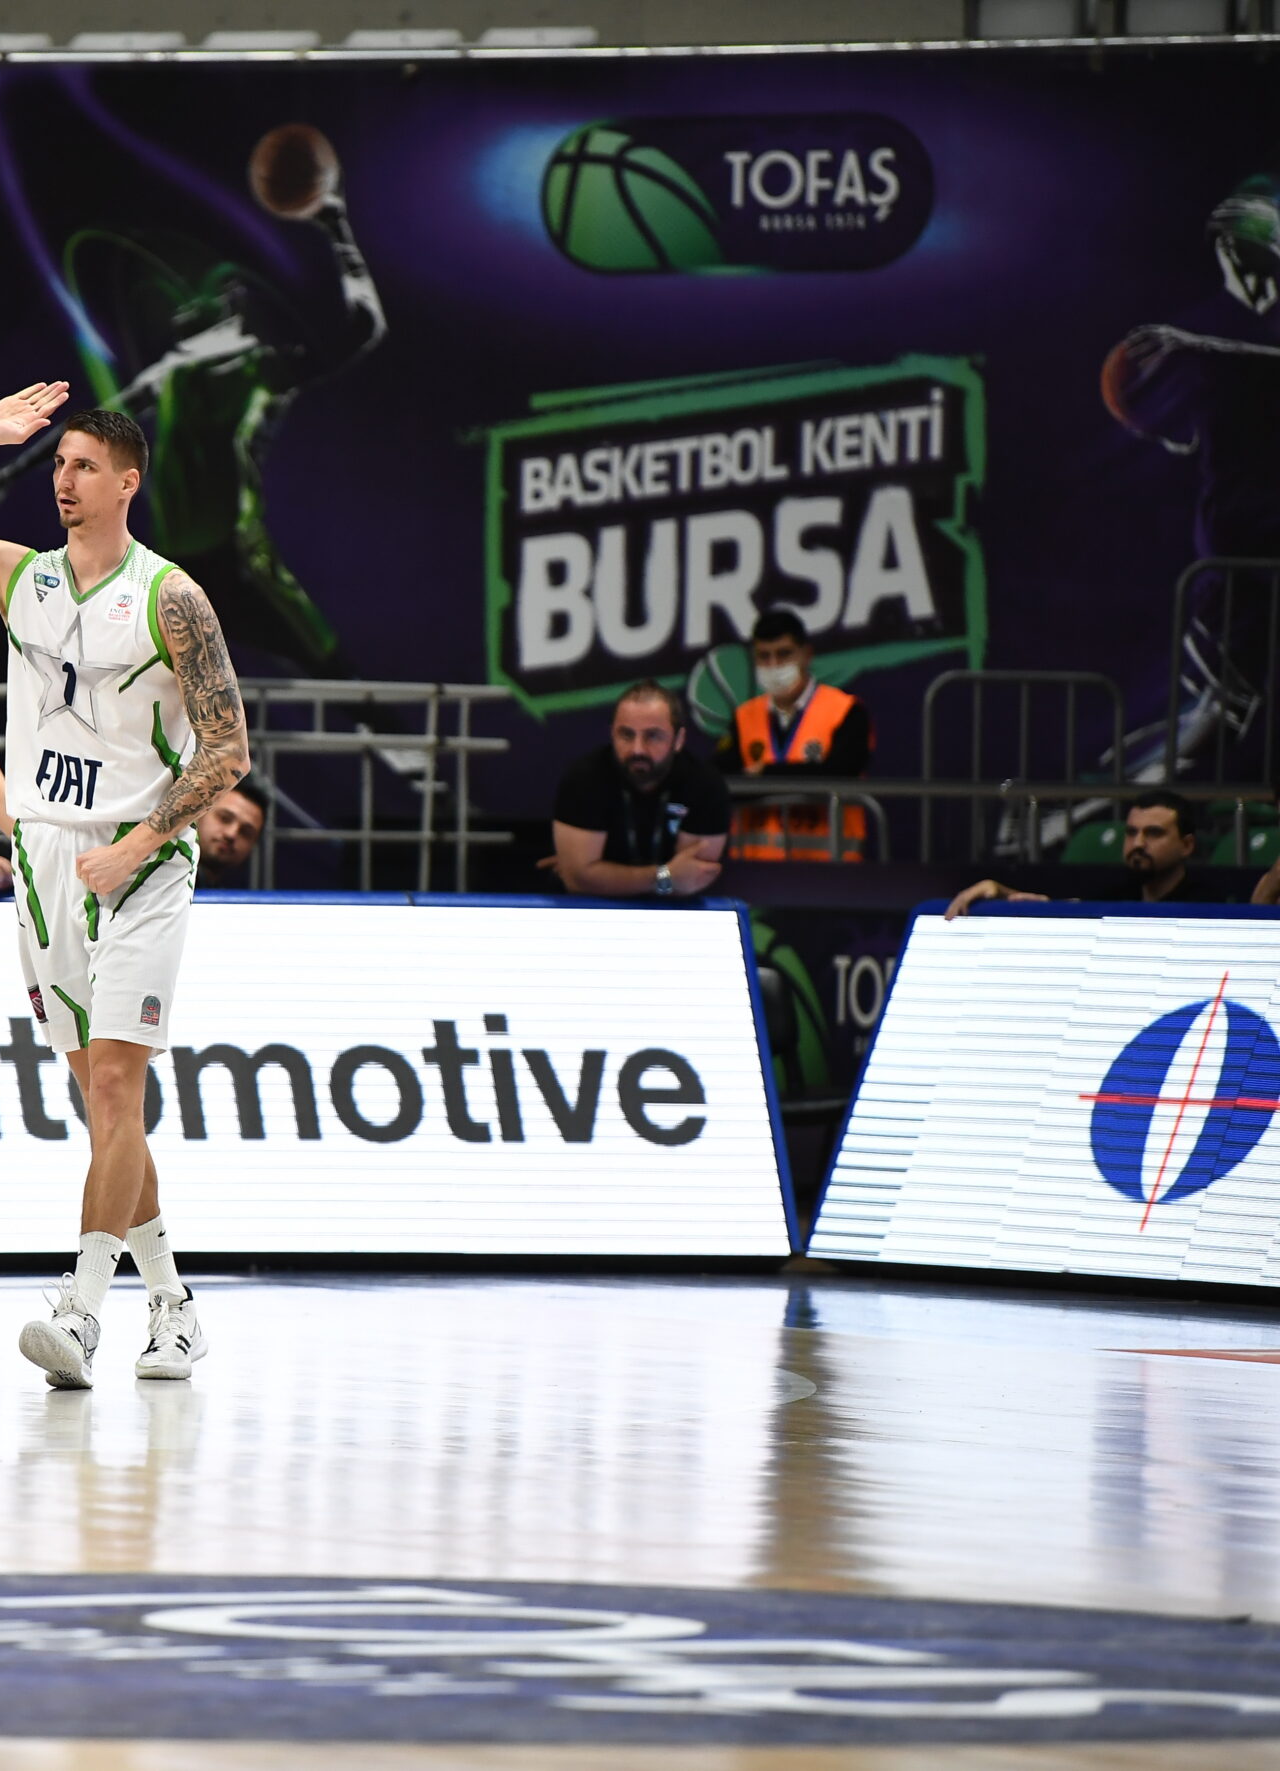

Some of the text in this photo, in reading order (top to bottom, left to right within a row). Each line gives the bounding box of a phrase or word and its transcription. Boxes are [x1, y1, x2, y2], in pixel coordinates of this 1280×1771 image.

[725, 148, 900, 222] TOFAŞ
[521, 388, 944, 514] BASKETBOL KENTİ
[518, 486, 936, 672] BURSA
[62, 661, 77, 707] 1
[36, 749, 103, 810] FIAT
